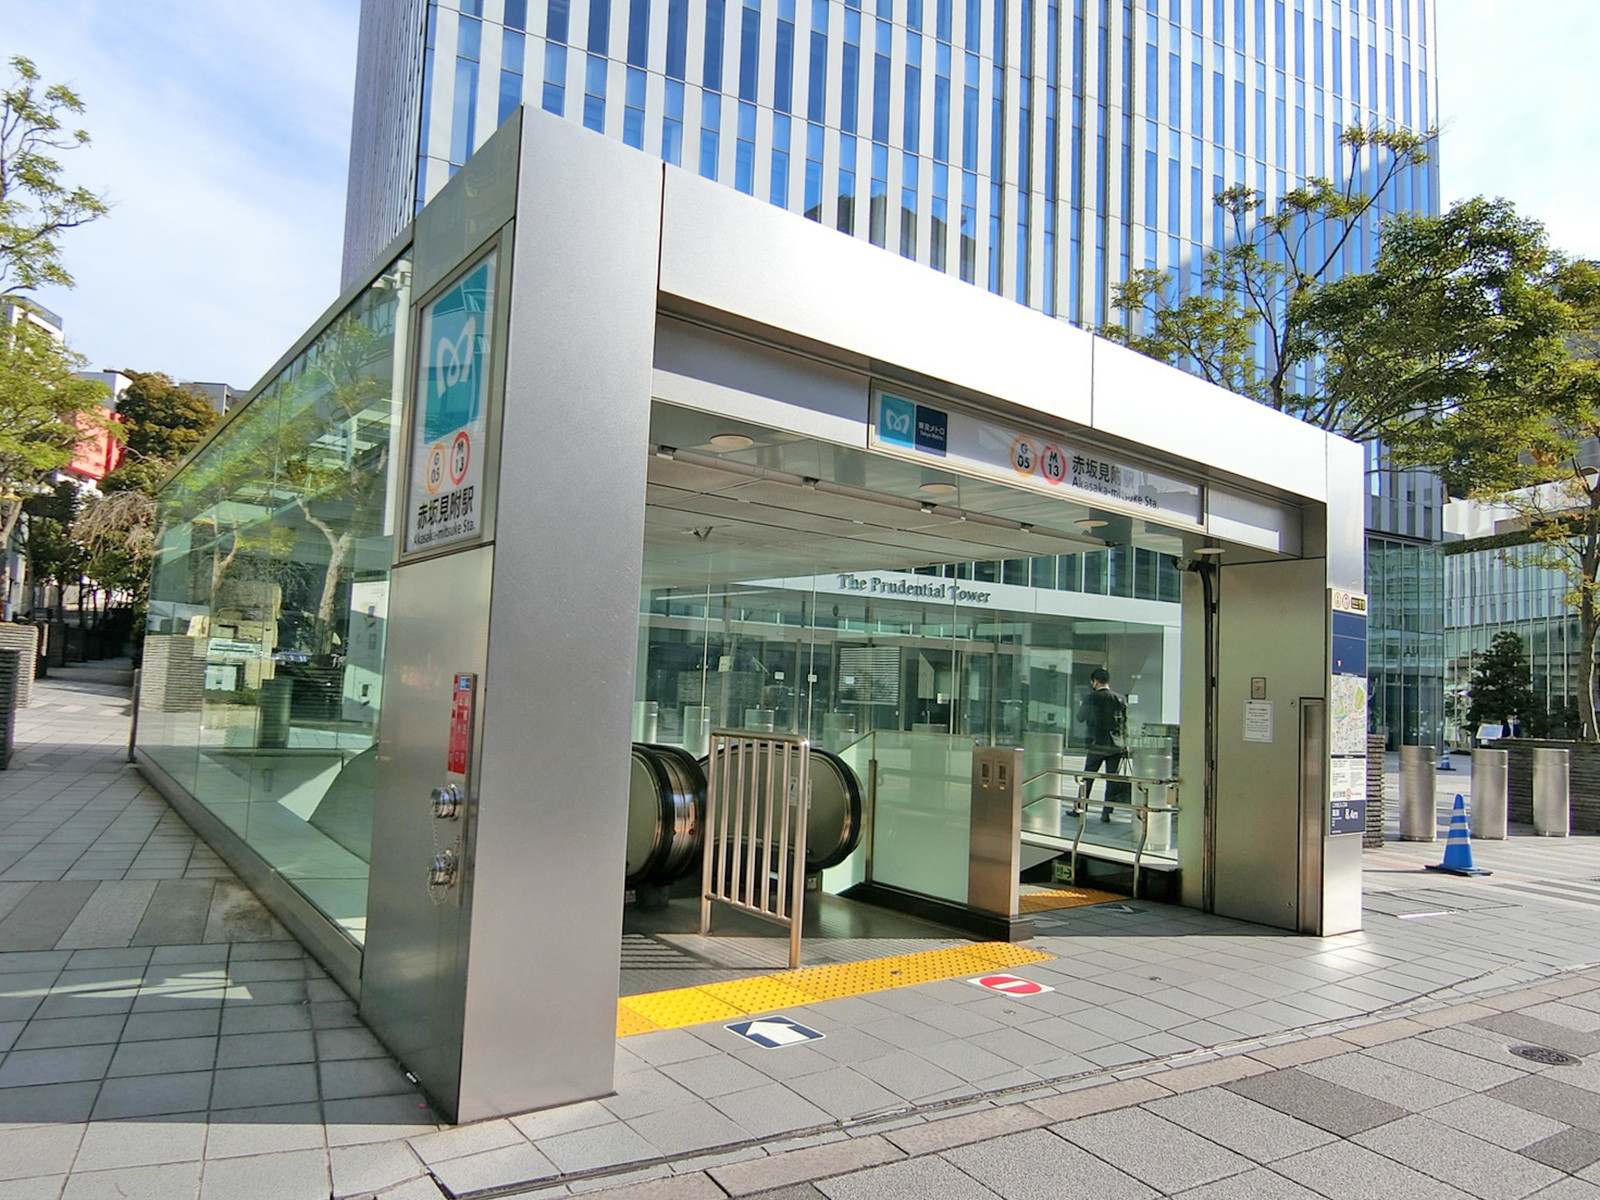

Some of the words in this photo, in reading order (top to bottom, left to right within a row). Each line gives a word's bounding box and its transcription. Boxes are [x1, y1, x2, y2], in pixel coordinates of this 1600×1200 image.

[456, 440, 464, 454] M
[1020, 443, 1029, 454] G
[433, 452, 440, 466] G
[1017, 455, 1031, 469] 05
[1049, 451, 1058, 463] M
[455, 456, 465, 473] 13
[1048, 463, 1060, 477] 13
[430, 467, 440, 484] 05
[417, 485, 474, 530] 赤坂見附駅
[1144, 495, 1159, 510] Sta.
[462, 518, 476, 534] Sta.
[838, 573, 867, 592] The
[870, 576, 946, 600] Prudential
[947, 584, 991, 604] Tower
